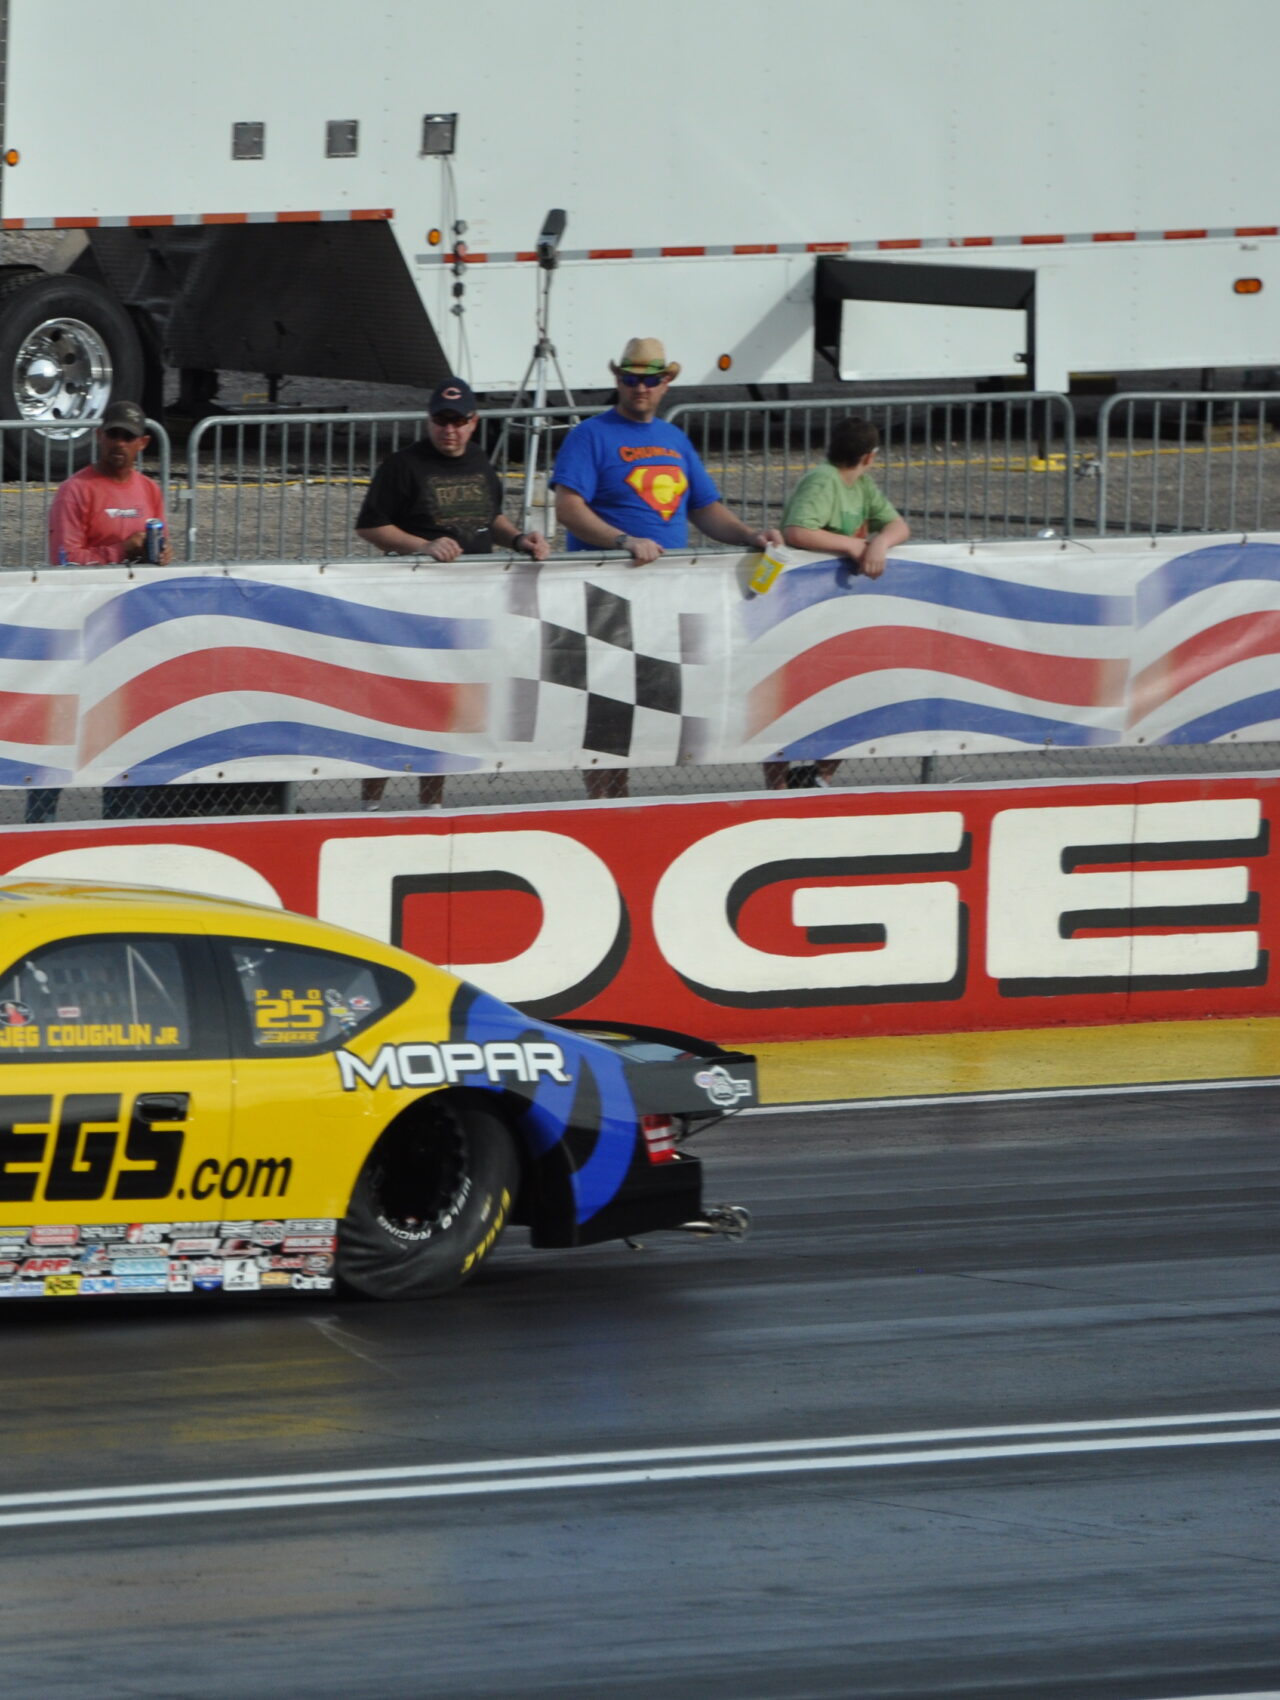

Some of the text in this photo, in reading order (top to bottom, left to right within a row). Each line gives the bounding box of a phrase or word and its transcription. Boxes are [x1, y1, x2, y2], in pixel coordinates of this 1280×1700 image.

[255, 989, 321, 1000] PRO
[255, 999, 325, 1029] 25
[47, 1024, 152, 1046] COUGHLIN
[155, 1027, 181, 1045] JR
[335, 1042, 572, 1090] MOPAR
